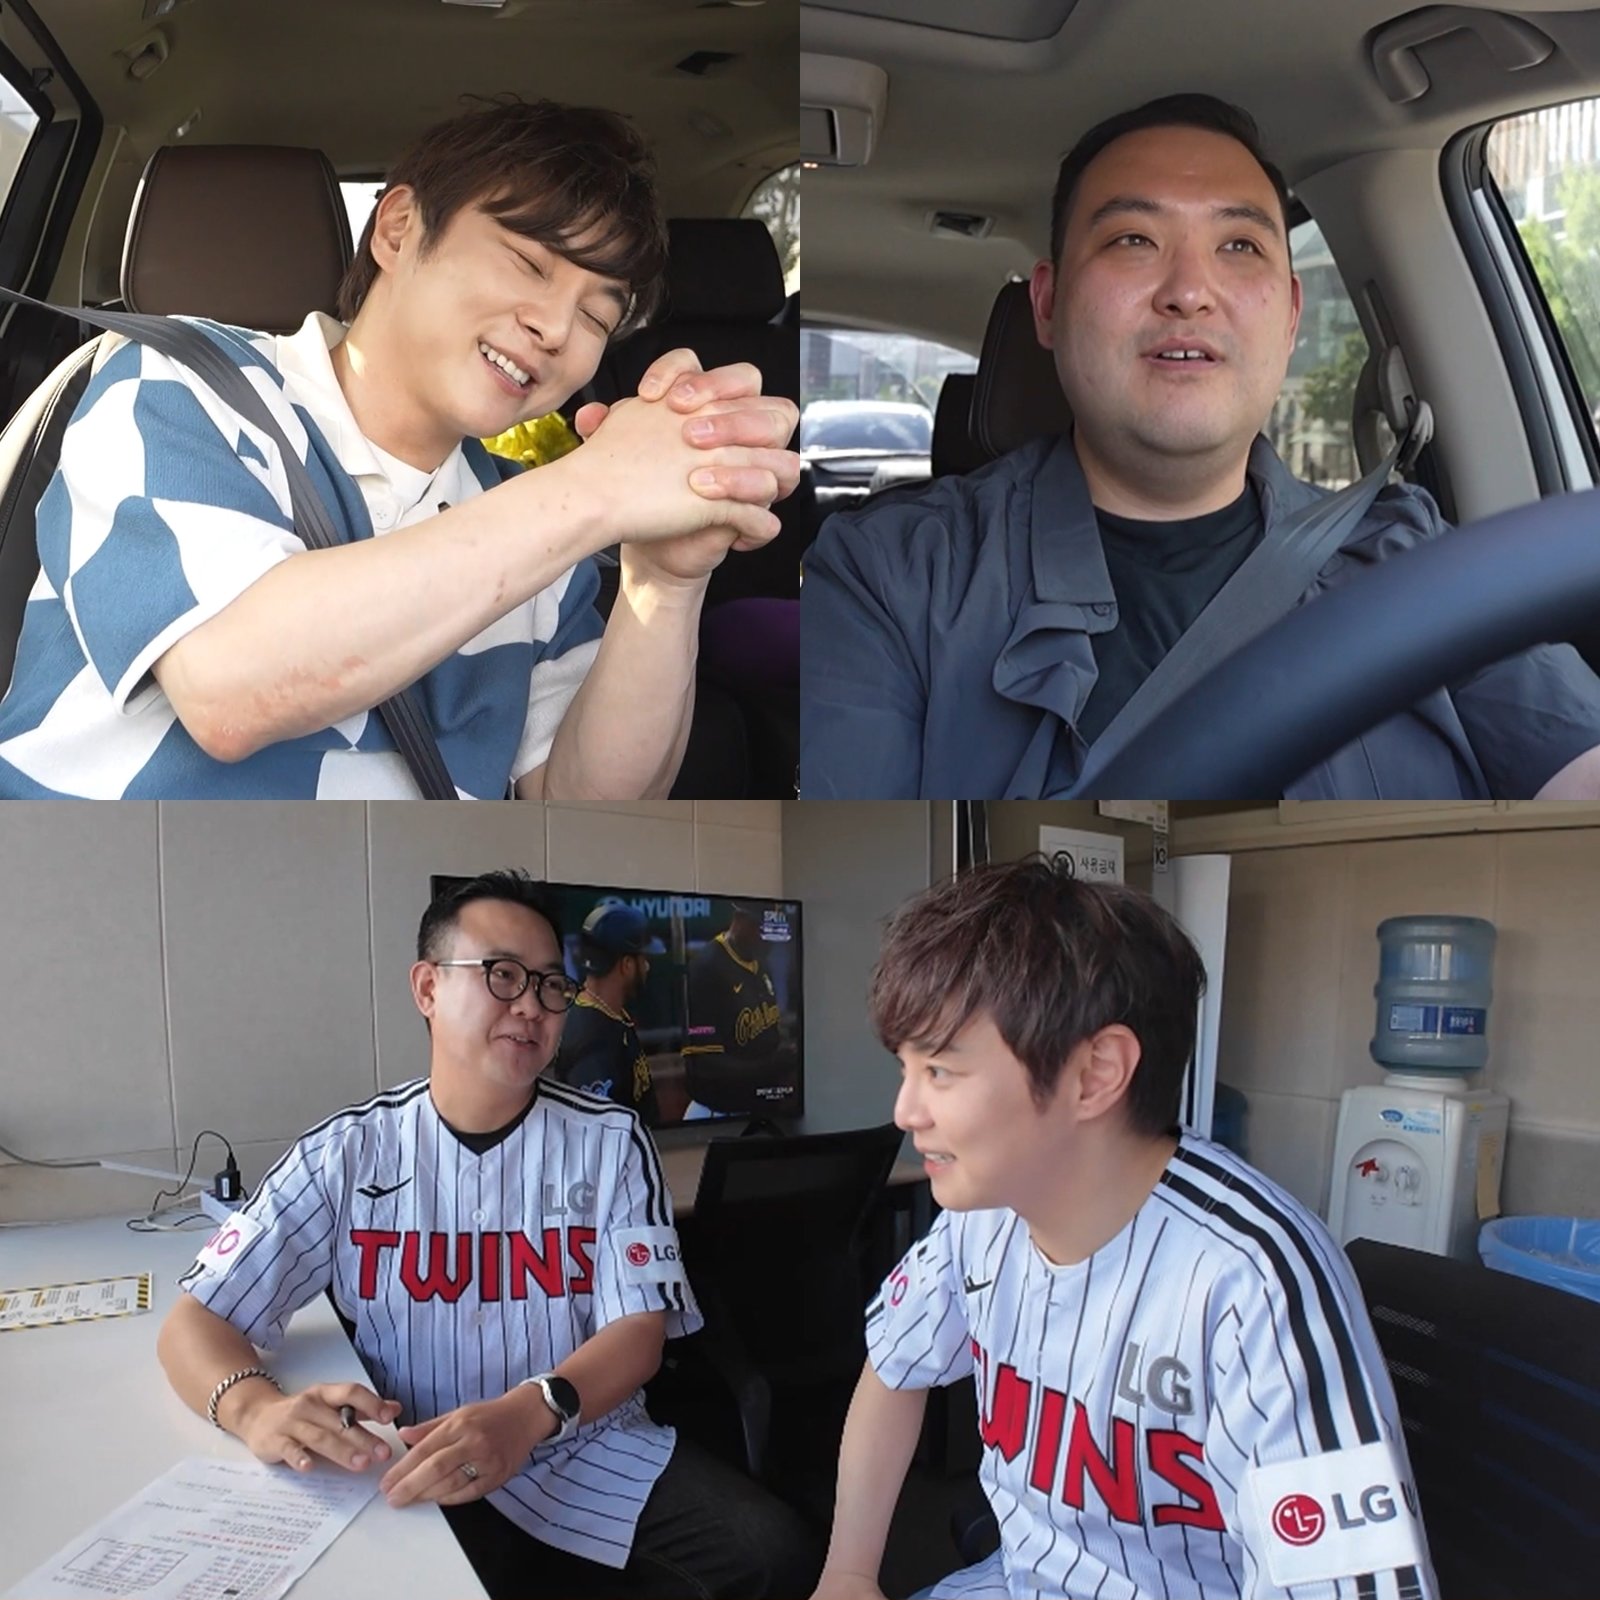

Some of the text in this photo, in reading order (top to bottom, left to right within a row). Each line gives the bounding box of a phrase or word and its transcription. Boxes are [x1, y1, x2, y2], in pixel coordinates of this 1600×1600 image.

[543, 1181, 595, 1217] LG
[350, 1227, 596, 1303] TWINS
[653, 1244, 676, 1262] LG
[1117, 1341, 1195, 1416] LG
[971, 1338, 1227, 1533] WINS
[1331, 1485, 1397, 1530] LG
